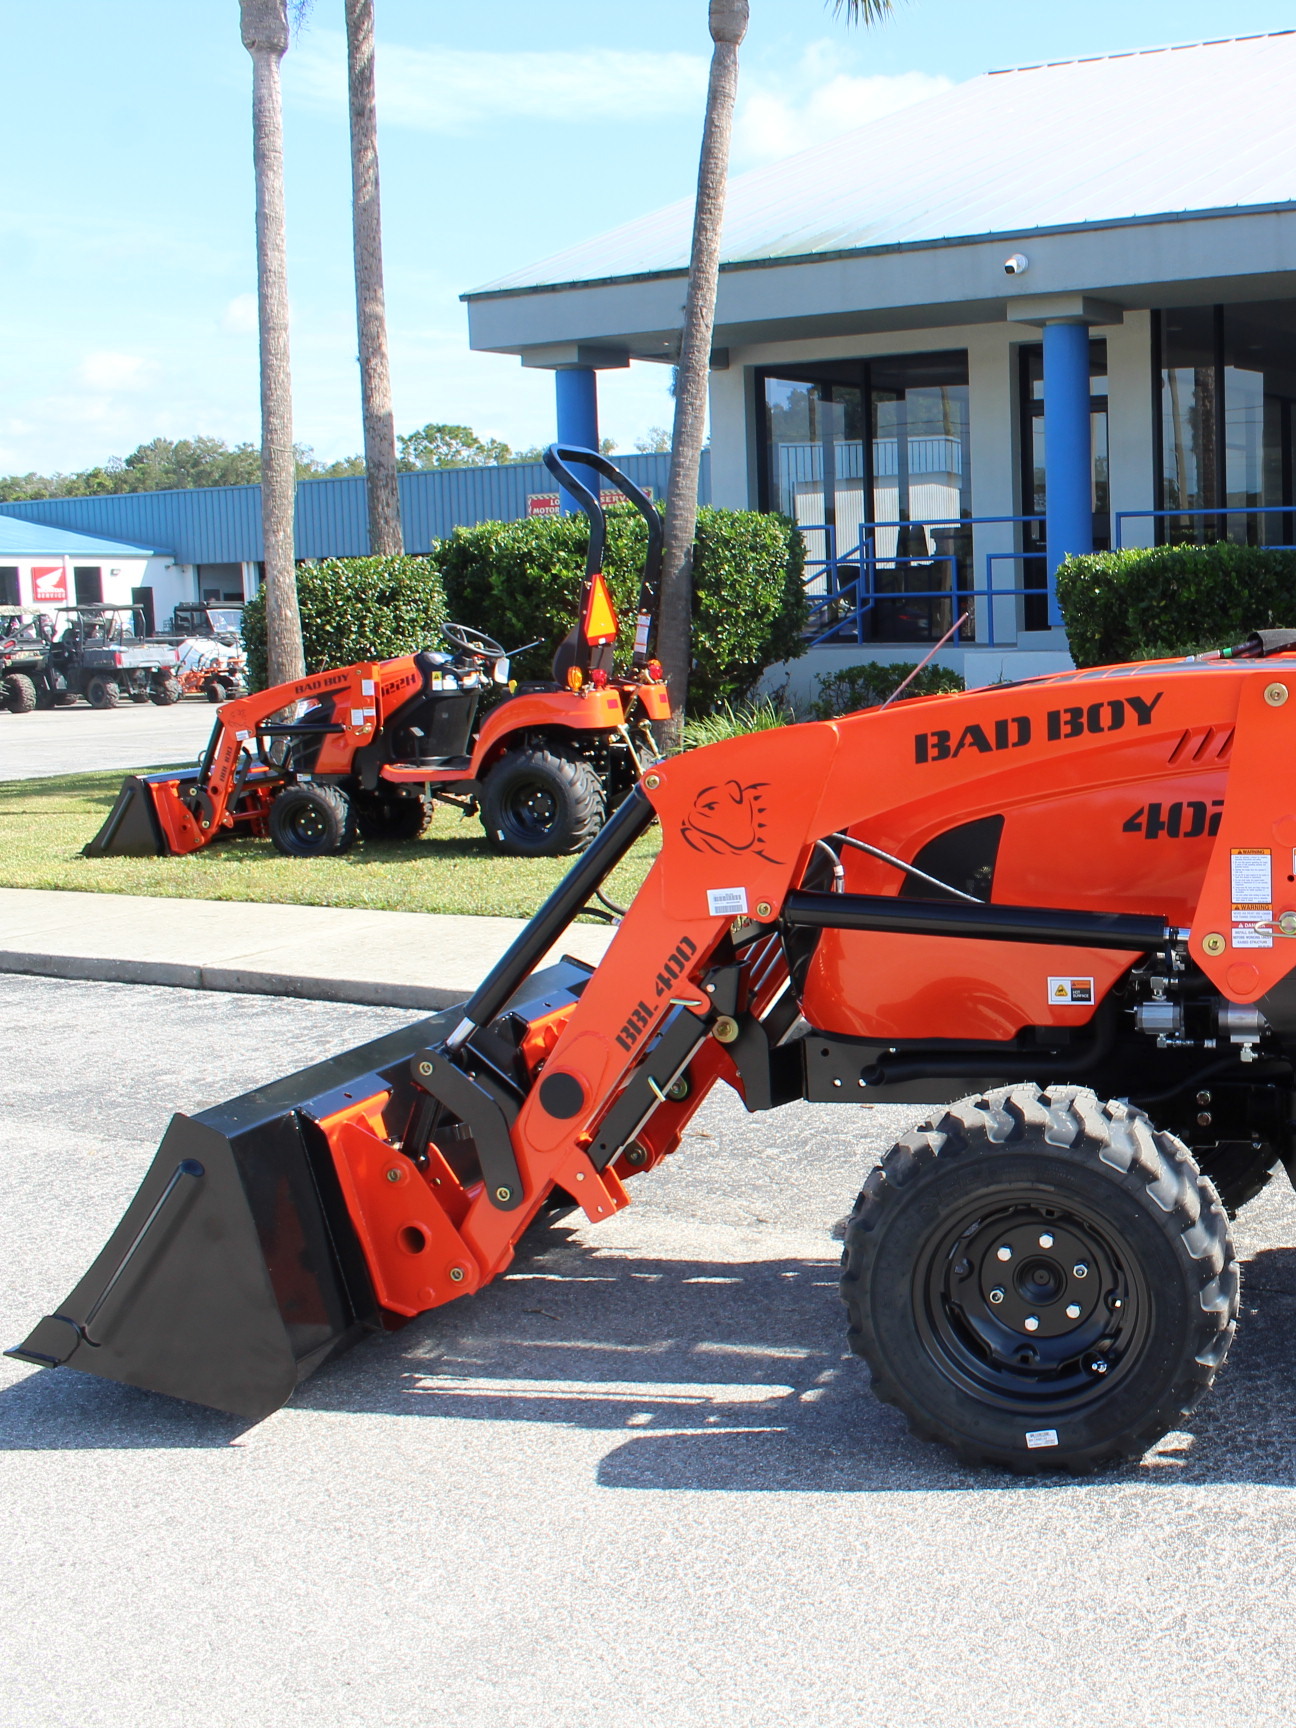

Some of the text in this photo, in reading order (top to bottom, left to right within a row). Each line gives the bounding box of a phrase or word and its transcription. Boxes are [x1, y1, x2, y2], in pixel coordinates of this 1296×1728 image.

[295, 673, 349, 694] BAD BOY
[915, 691, 1165, 764] BAD BOY
[655, 936, 697, 997] 400
